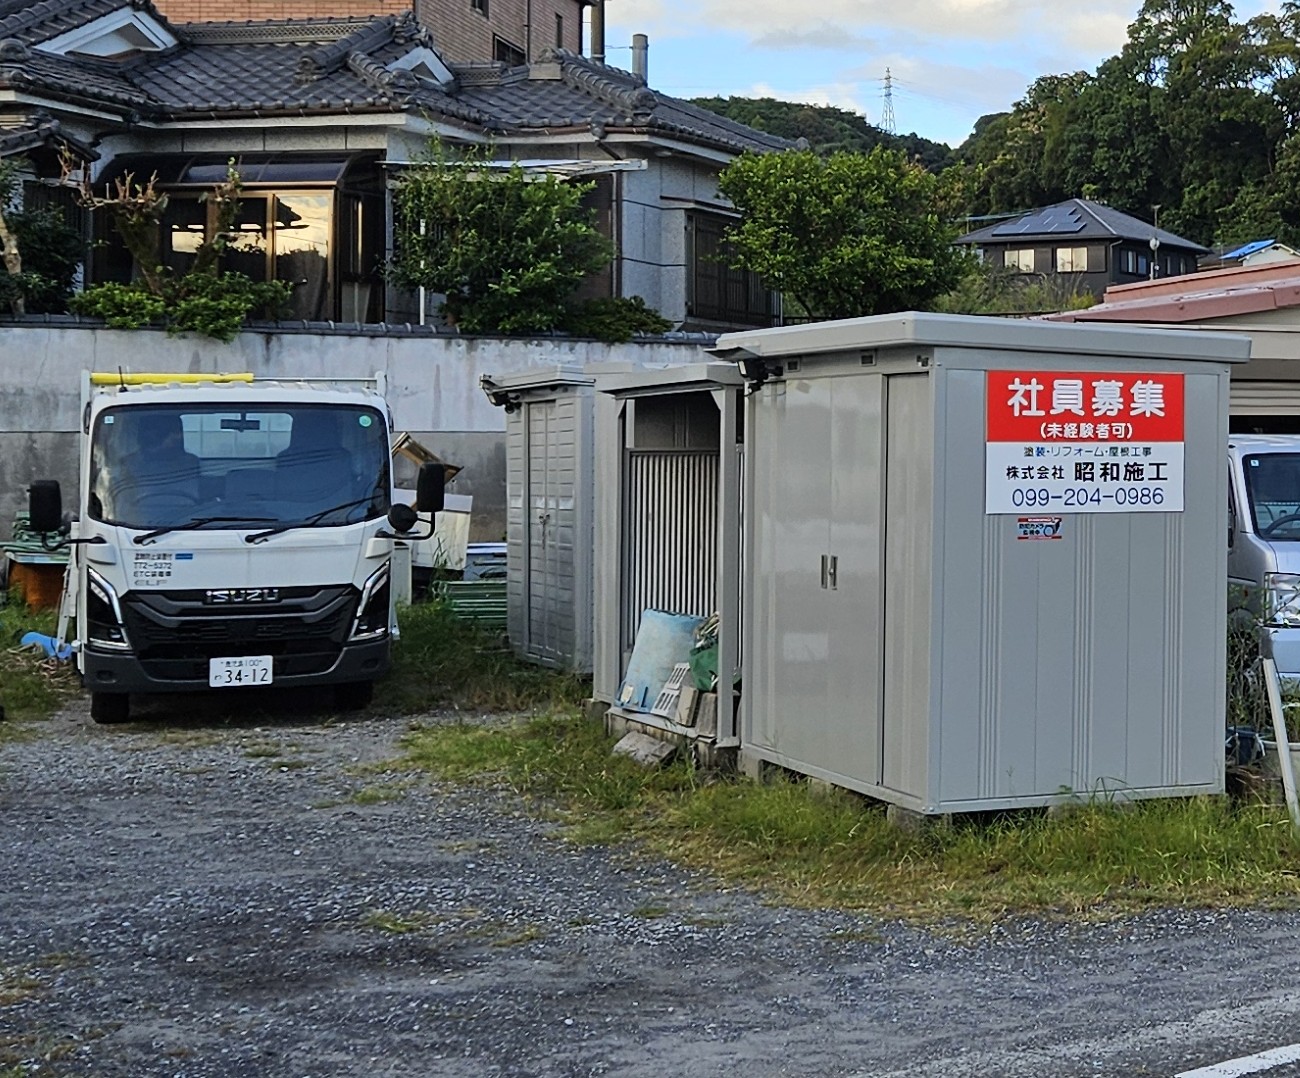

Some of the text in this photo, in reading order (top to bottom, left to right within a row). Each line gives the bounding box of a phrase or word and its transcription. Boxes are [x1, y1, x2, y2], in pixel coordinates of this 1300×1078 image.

[1007, 377, 1165, 418] 社員募集
[1040, 422, 1133, 439] (未経験者可)
[1006, 461, 1168, 482] 株式会社 昭和施工
[1012, 487, 1164, 506] 099-204-0986
[206, 589, 279, 602] ISUZU
[224, 668, 268, 683] 34-12
